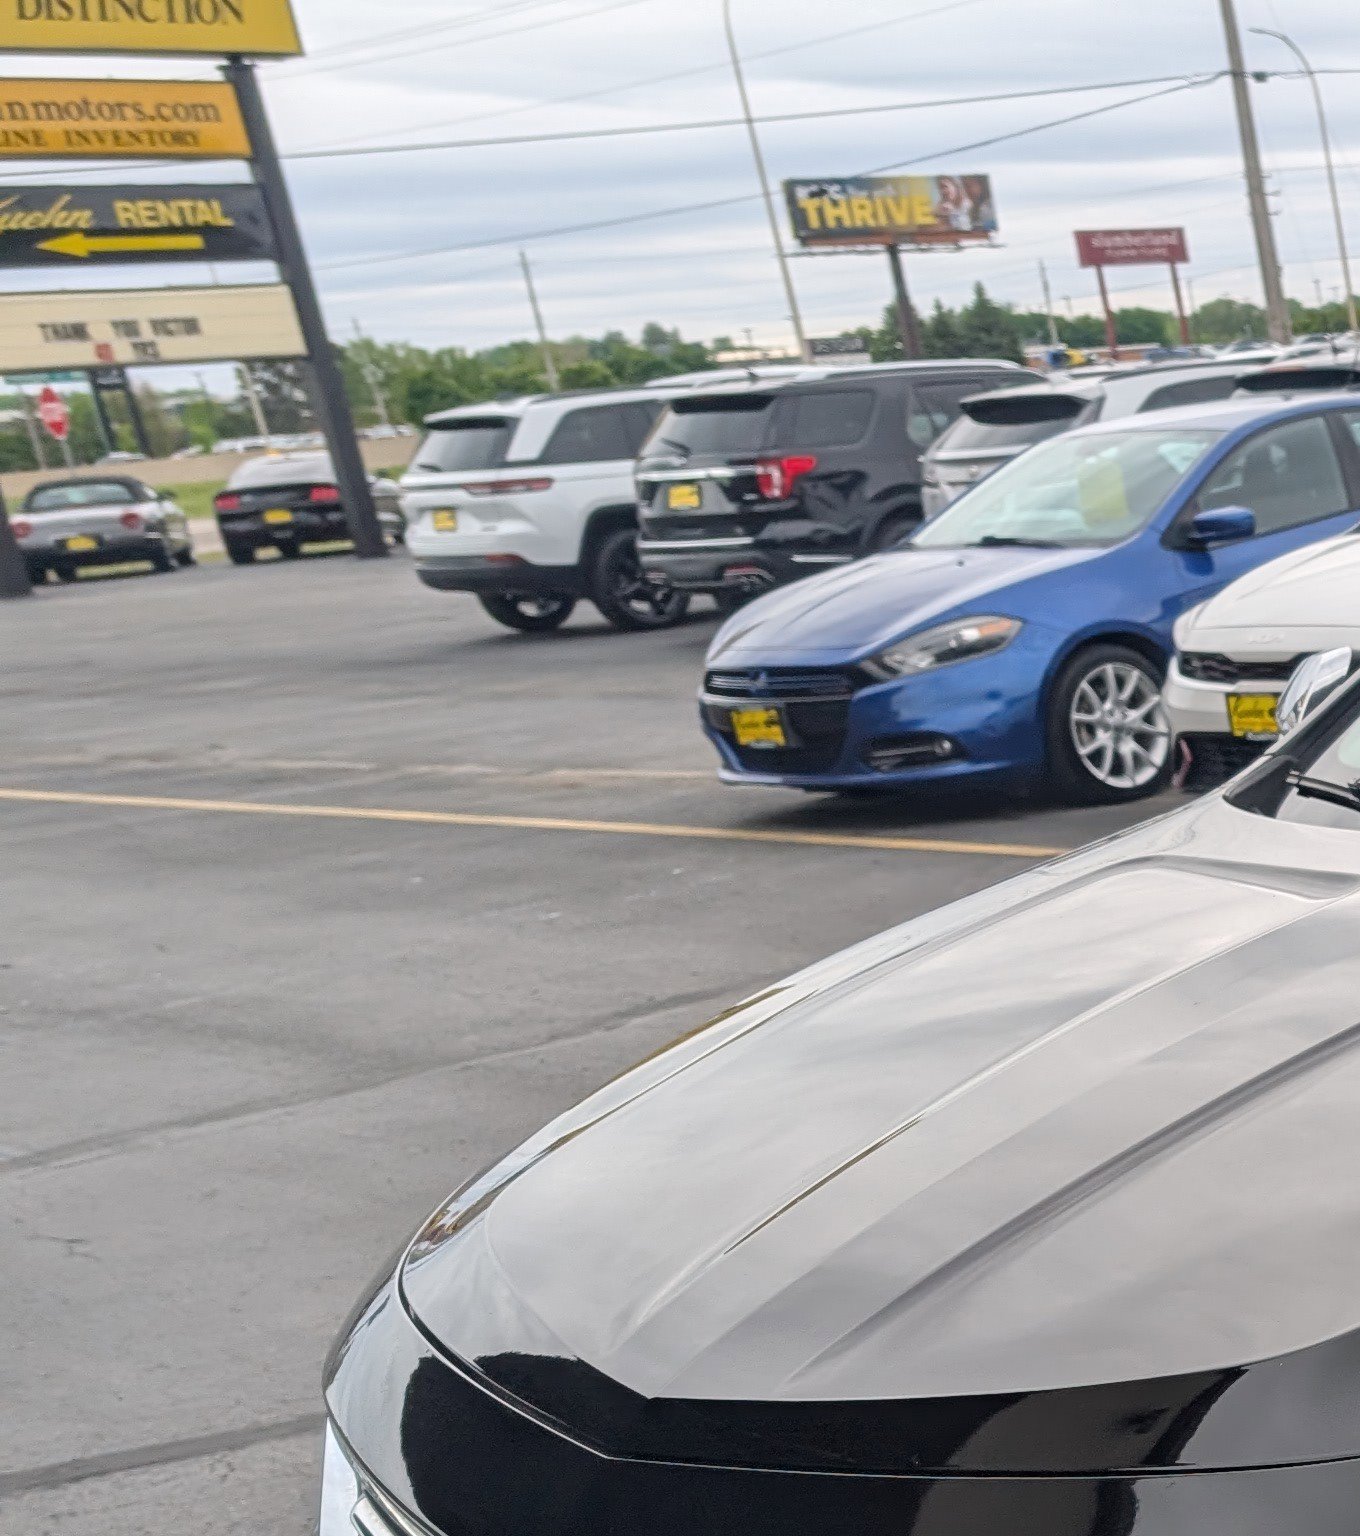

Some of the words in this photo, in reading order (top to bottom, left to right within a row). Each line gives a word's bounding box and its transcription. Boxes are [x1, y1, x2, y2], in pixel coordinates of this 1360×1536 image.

[0, 97, 222, 123] nmotors.com
[112, 198, 236, 228] RENTAL
[797, 194, 939, 230] THRIVE
